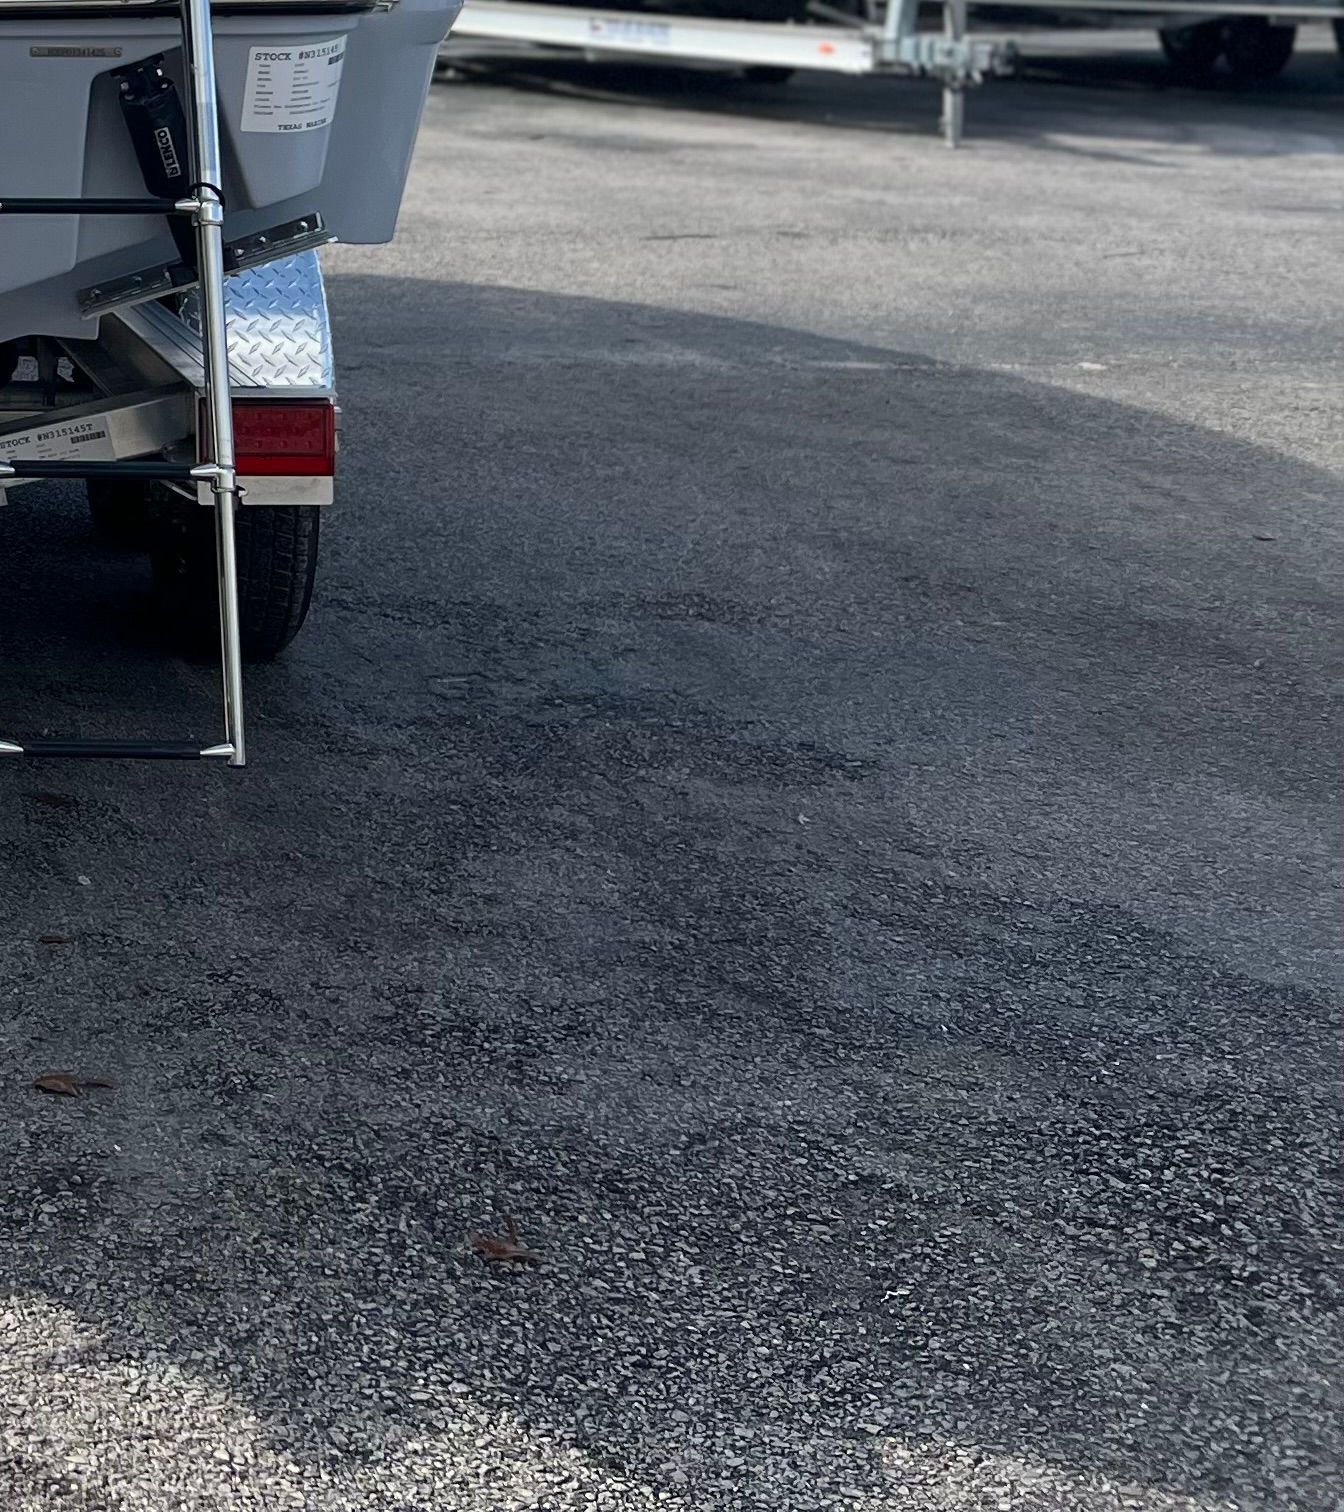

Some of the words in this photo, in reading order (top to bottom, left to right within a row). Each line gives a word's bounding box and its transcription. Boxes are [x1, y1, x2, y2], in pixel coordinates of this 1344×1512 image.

[254, 52, 292, 61] STOCK
[157, 129, 177, 168] LENCO
[0, 436, 31, 449] STOCK
[37, 423, 93, 441] #N315145T
